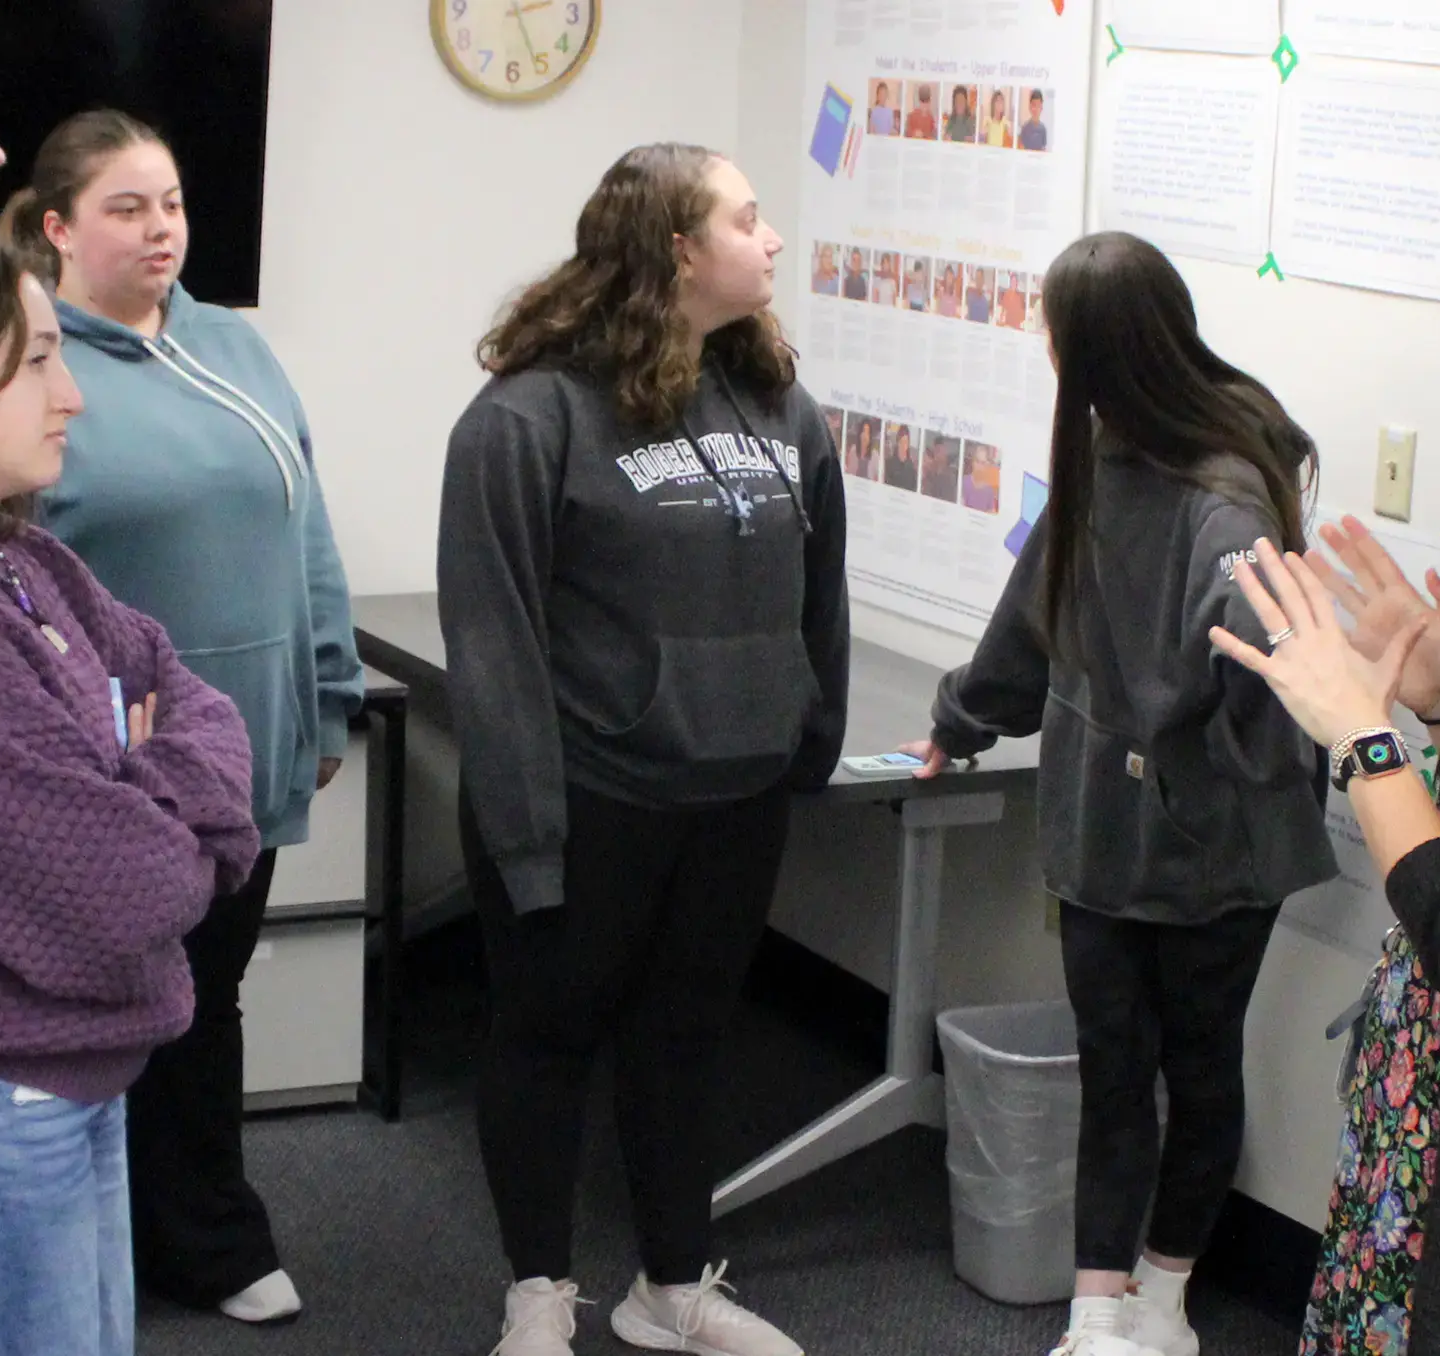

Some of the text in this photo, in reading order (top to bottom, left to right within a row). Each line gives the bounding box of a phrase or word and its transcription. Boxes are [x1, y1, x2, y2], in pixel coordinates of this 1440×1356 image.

[452, 0, 467, 21] 9
[565, 2, 579, 25] 3
[456, 28, 471, 51] 8
[554, 32, 569, 53] 4
[477, 50, 494, 73] 7
[505, 61, 520, 84] 6
[535, 52, 549, 75] 5
[616, 431, 800, 493] ROGER WILLIMS
[676, 472, 774, 486] UNIVRSITY
